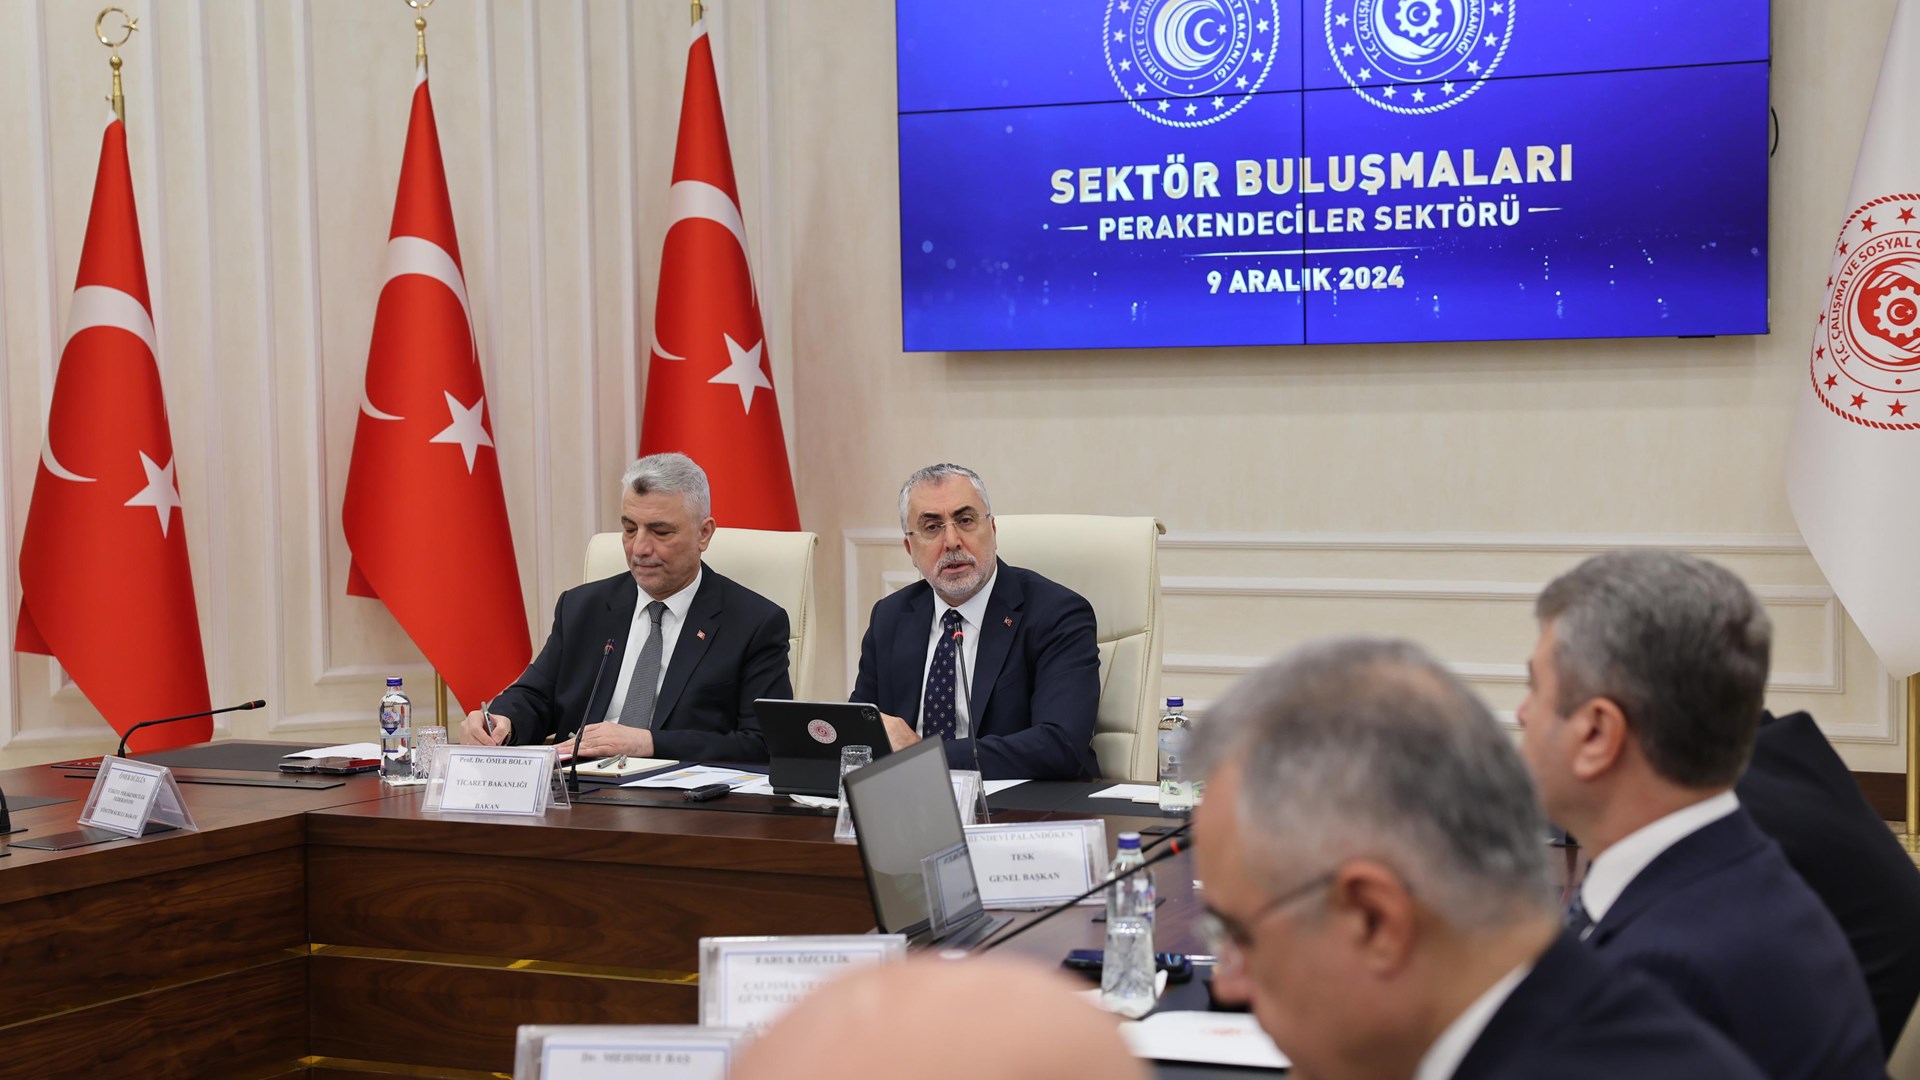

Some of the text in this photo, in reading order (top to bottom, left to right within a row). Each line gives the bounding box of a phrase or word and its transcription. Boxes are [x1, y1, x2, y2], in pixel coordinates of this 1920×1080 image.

[1050, 144, 1572, 204] SEKTÖR BULUŞMALARI
[1099, 194, 1520, 241] PERAKENDECİLER SEKTÖRÜ
[1206, 265, 1405, 294] 9 ARALIK 2024
[1831, 236, 1912, 365] T.C. ÇALIŞMA VE SOSYAL
[486, 756, 507, 765] ÖMER
[456, 779, 528, 789] TİCARET BAKANLIĞI
[1011, 853, 1035, 861] TESK
[989, 872, 1061, 883] GENEL BAŞKAN
